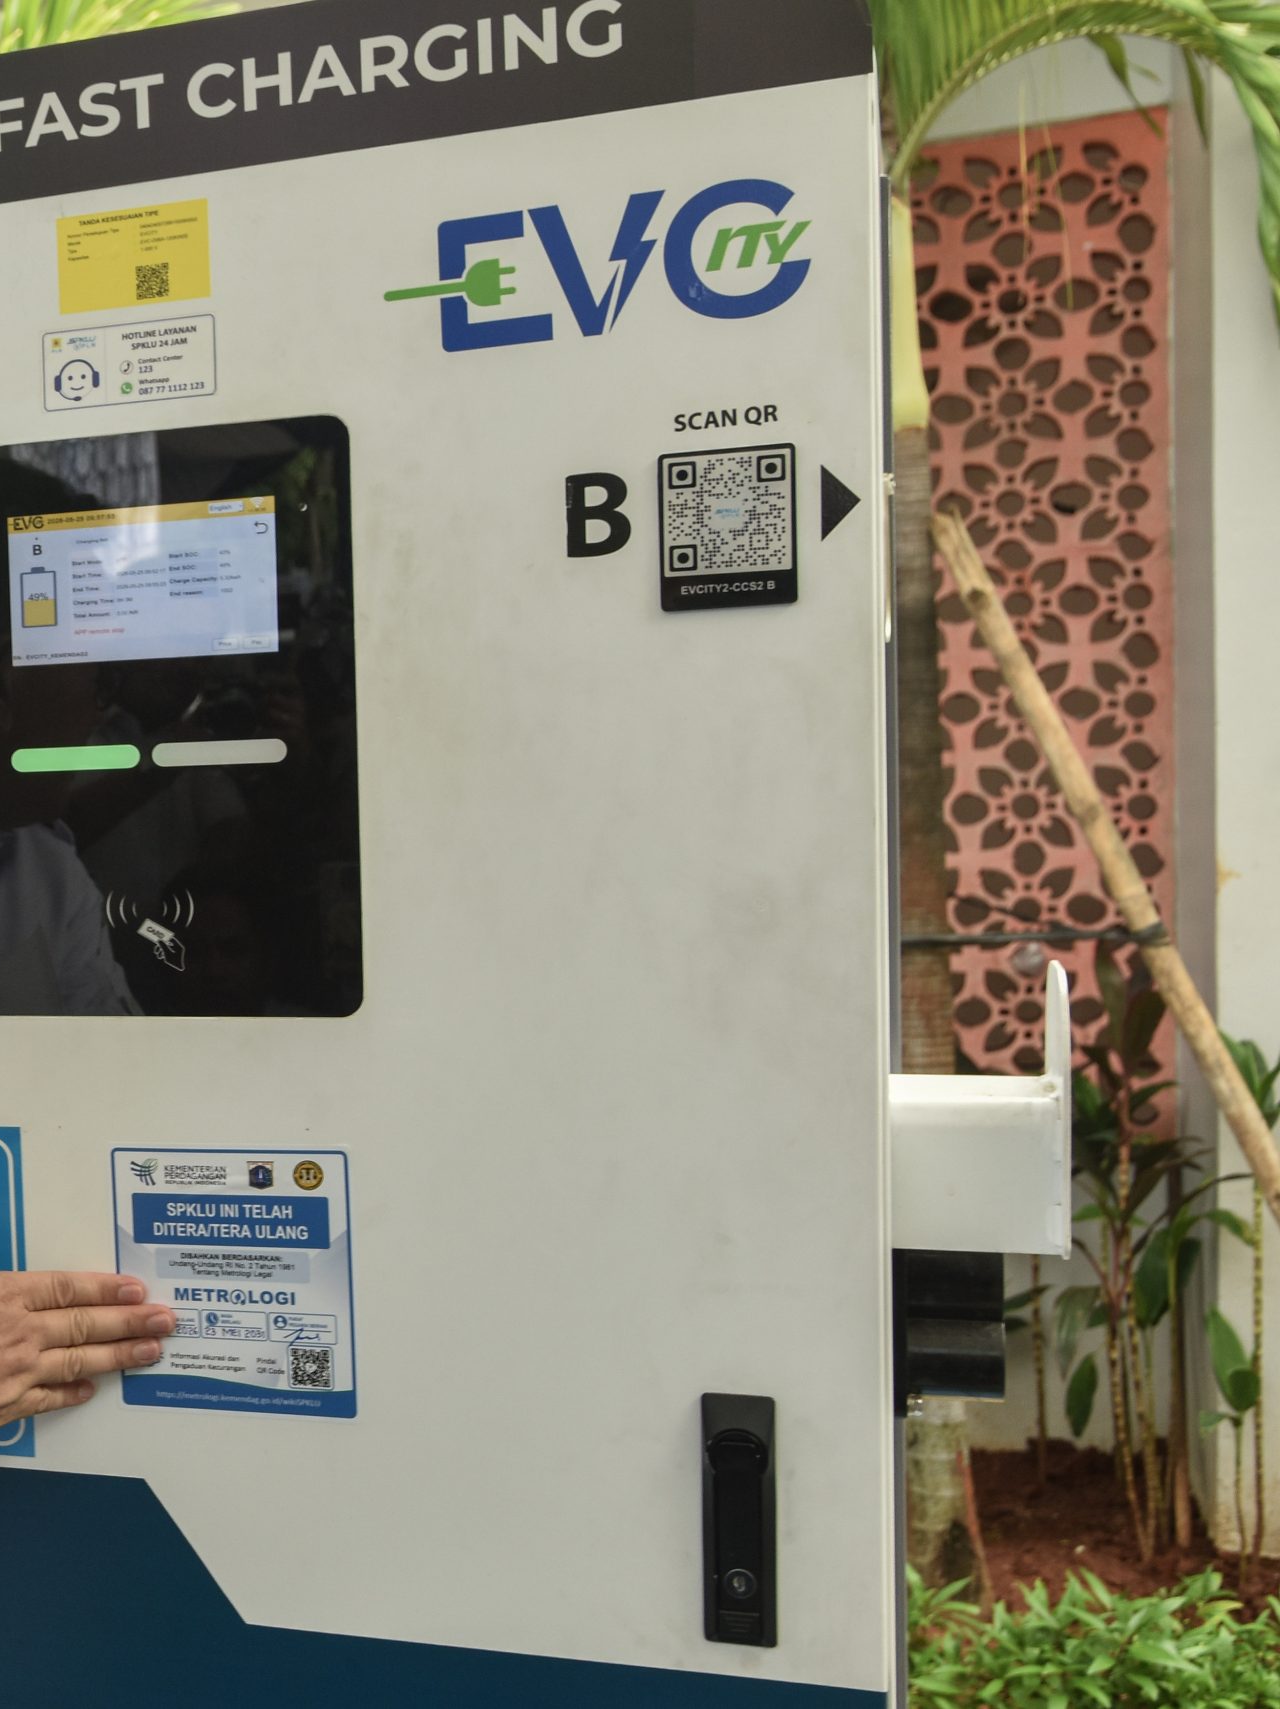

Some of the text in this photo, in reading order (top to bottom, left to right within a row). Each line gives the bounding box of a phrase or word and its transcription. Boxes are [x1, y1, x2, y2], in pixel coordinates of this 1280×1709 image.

[186, 0, 623, 118] CHARGING
[79, 219, 100, 227] TANDA
[122, 325, 197, 341] HOTLINE LAYANAN
[131, 341, 157, 350] SPKLU
[170, 337, 188, 346] JAM
[138, 357, 161, 365] Contact
[138, 365, 153, 373] 123
[138, 387, 154, 395] 087
[169, 384, 187, 392] 1112
[190, 381, 205, 390] 123
[674, 405, 778, 432] SCAN QR
[565, 472, 631, 558] B
[32, 544, 43, 556] B
[681, 581, 776, 595] EVCITY2-CCS2 B
[27, 592, 49, 602] 49%
[146, 926, 166, 939] CARD
[164, 1164, 227, 1173] KEMENTERIAN
[164, 1172, 227, 1180] PERDAGANGAN
[166, 1203, 293, 1220] SPKLU INI TELAH
[153, 1222, 309, 1240] DITERA/TERA ULANG
[180, 1252, 219, 1261] DISAHKAN
[169, 1260, 224, 1270] Undang-Undang
[192, 1268, 272, 1279] Tentang Metrologi Legal
[174, 1287, 296, 1306] METROLOGI
[170, 1352, 200, 1360] Informasi
[171, 1362, 247, 1373] Pengaduan Kecurangan
[268, 1367, 285, 1375] Code
